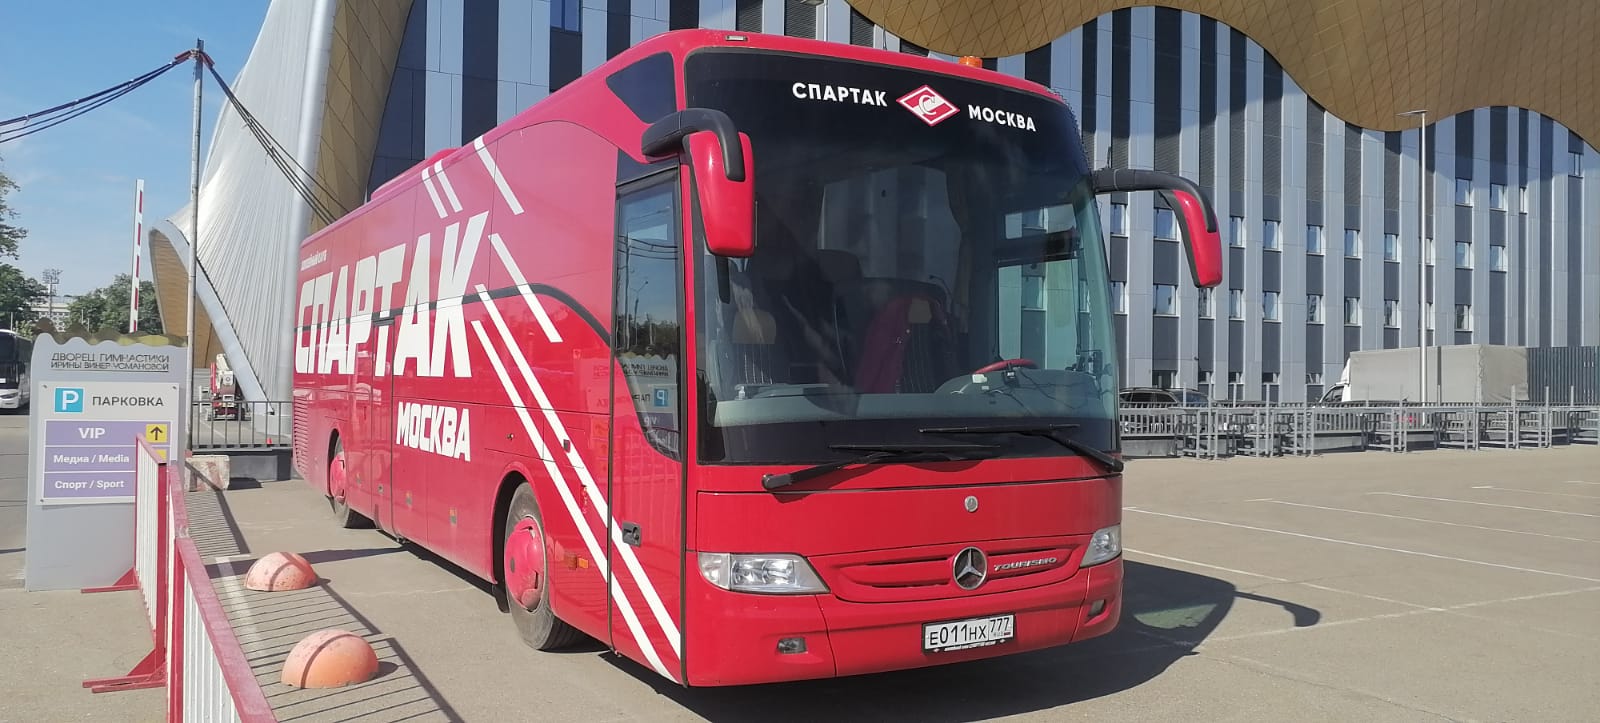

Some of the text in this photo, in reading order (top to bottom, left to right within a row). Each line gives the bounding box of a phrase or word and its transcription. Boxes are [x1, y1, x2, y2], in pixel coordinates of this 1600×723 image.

[792, 82, 888, 107] СПАРТАК
[967, 104, 1037, 132] МОСКВА
[294, 211, 489, 378] СПАРТАК
[51, 353, 169, 363] ДВОРЕЦ ГИМНАСТИКИ
[50, 361, 81, 369] ИРИНЫ
[62, 390, 79, 411] P
[92, 396, 164, 407] ПАРКОВКА
[78, 427, 106, 439] VIP
[395, 401, 471, 462] МОСКВА
[53, 454, 89, 465] Медиа
[98, 454, 130, 463] Media
[54, 480, 88, 491] Спорт
[96, 480, 125, 490] Sport
[994, 557, 1057, 571] TOURISMO
[989, 617, 1010, 632] 777
